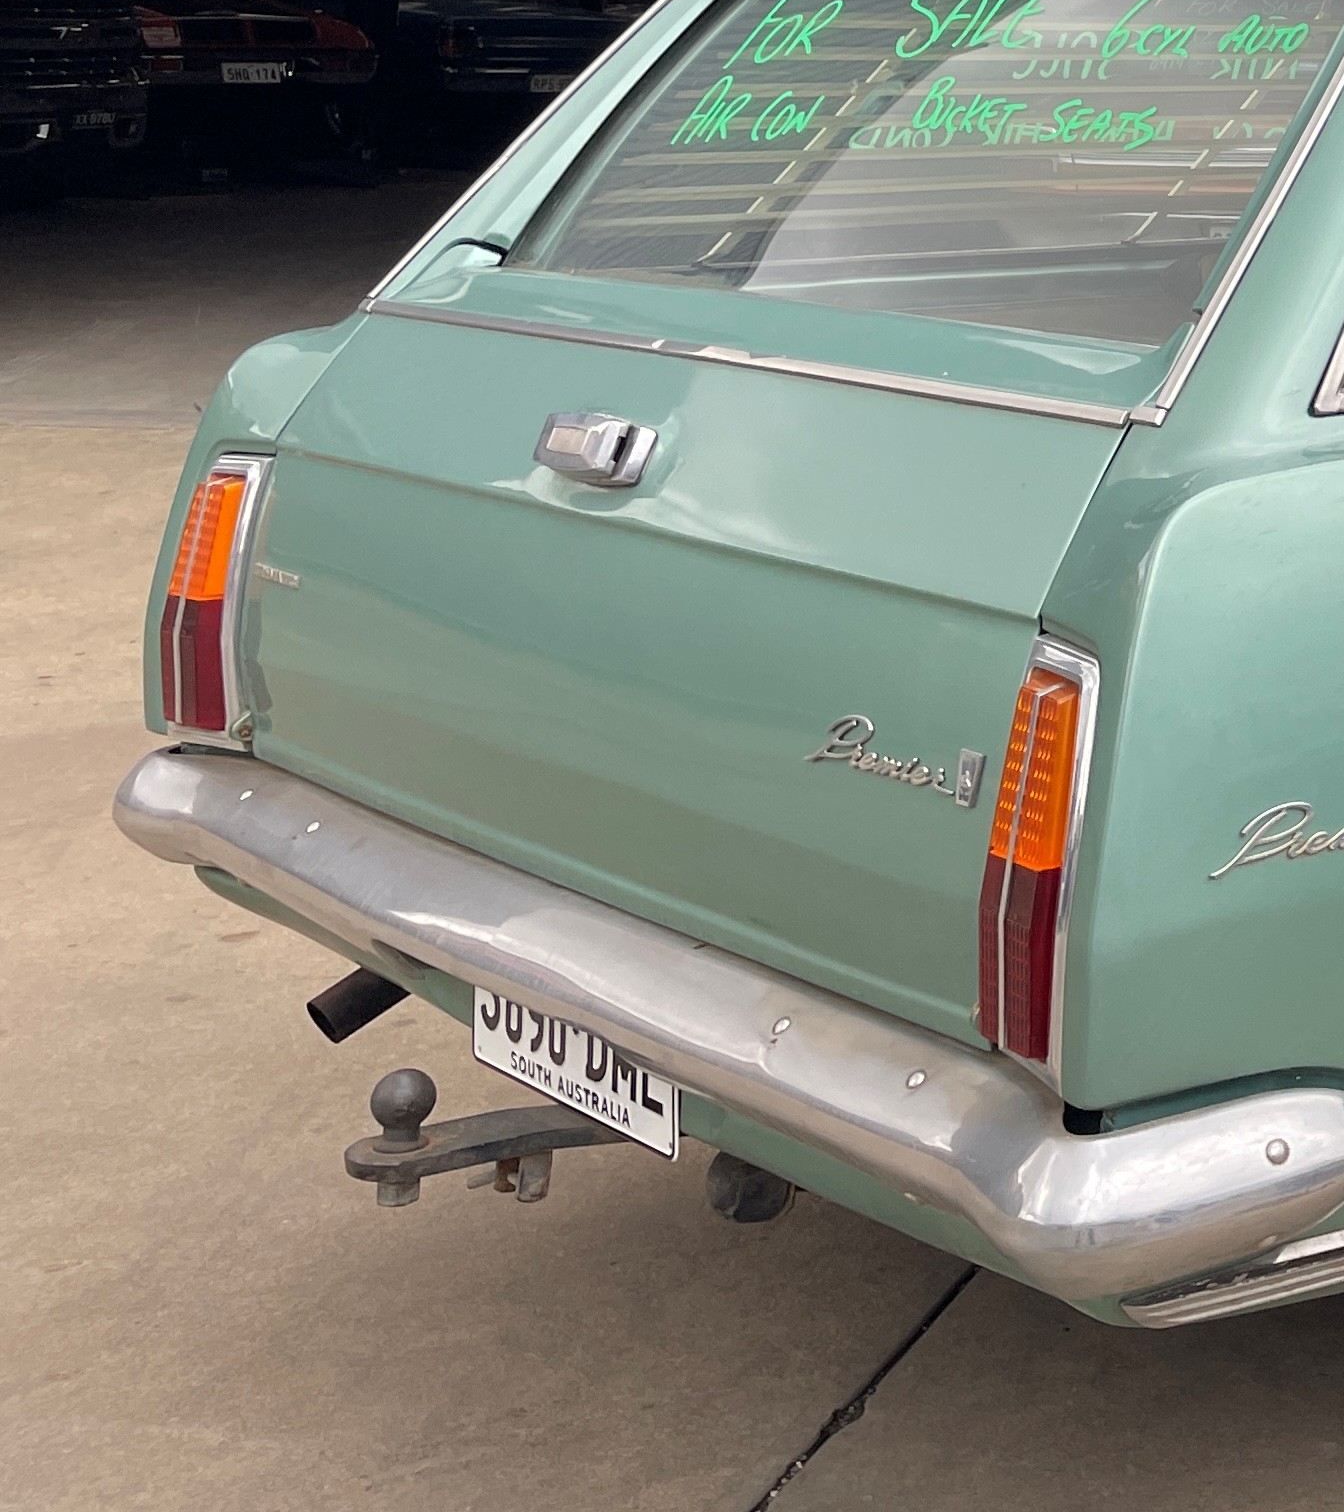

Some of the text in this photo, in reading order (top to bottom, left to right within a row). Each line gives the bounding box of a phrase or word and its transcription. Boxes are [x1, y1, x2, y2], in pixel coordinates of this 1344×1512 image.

[1217, 14, 1309, 54] AUTO
[670, 74, 826, 146] AIR CON
[912, 76, 1158, 151] BUCKET SEATS
[803, 713, 955, 796] Premier
[510, 1050, 632, 1129] SOUTH AUSTRALIA
